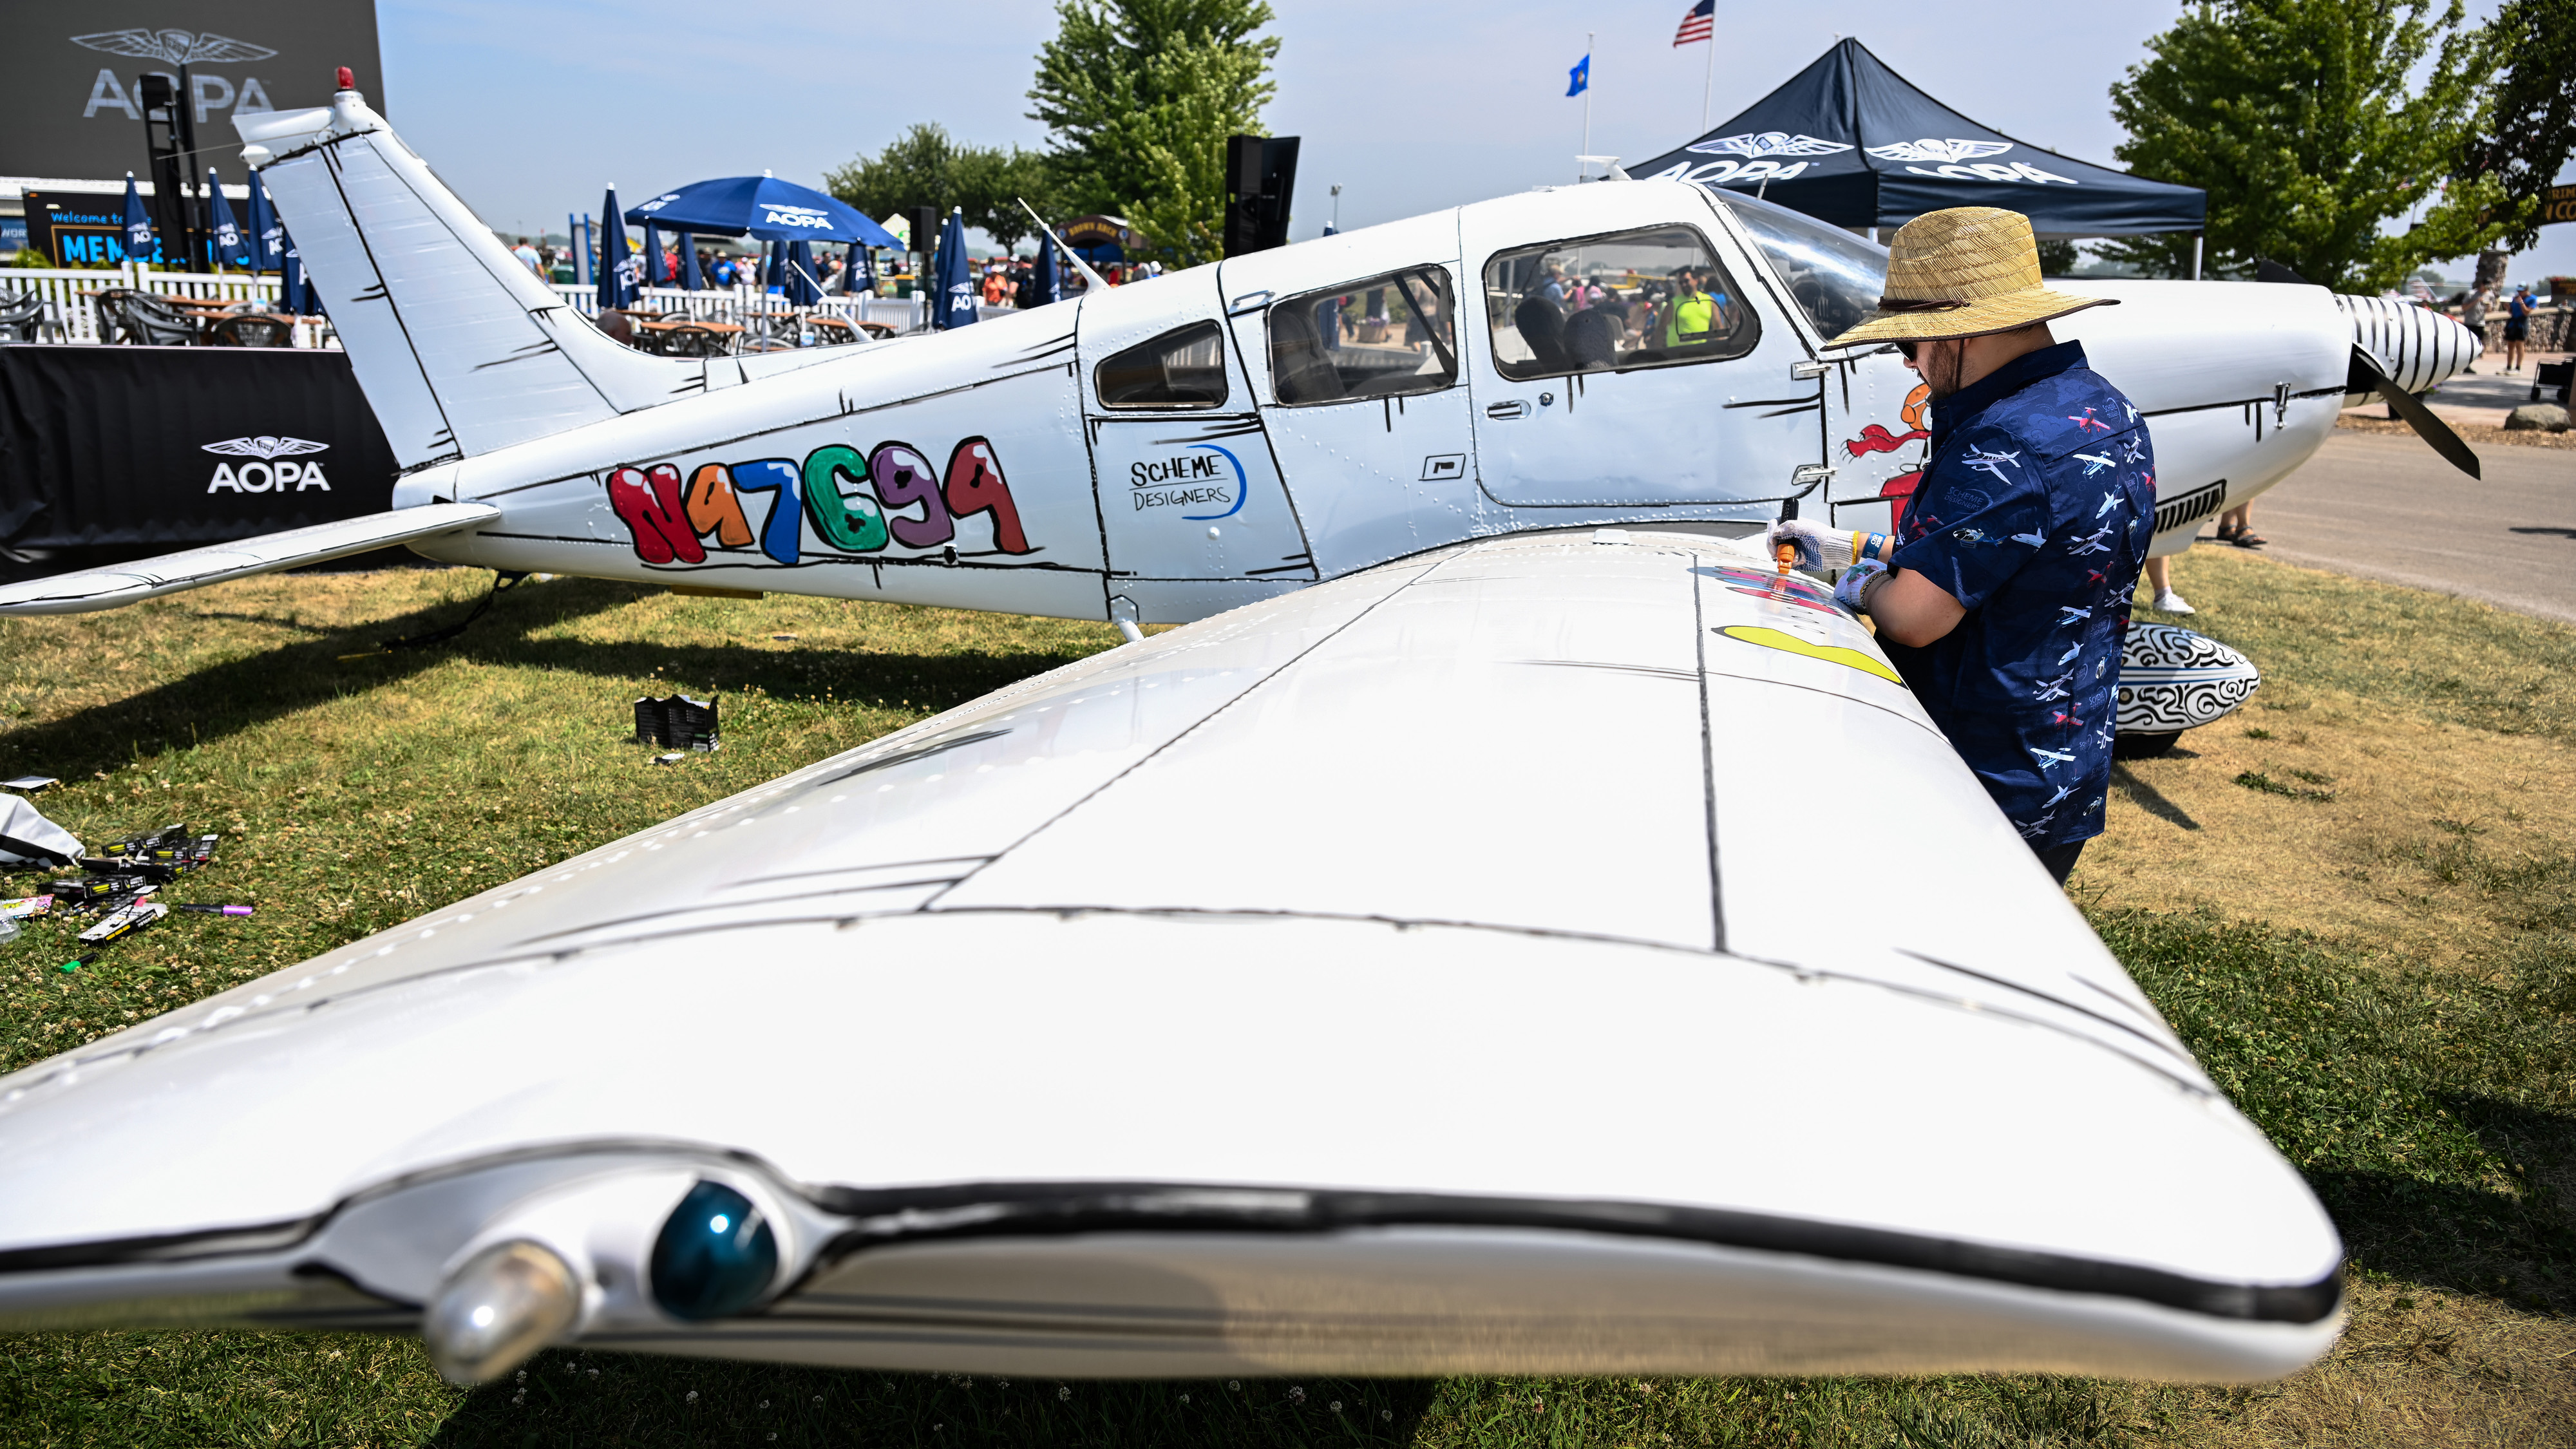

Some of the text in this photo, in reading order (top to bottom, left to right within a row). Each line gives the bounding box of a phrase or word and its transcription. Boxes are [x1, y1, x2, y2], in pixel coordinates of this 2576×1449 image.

[51, 211, 108, 223] Welcome
[765, 211, 835, 231] AOPA
[207, 461, 332, 494] AOPA
[1131, 454, 1222, 487] SCHEME
[1133, 487, 1231, 511] DESIGNERS
[1944, 495, 1981, 511] DESIGNERS
[1947, 486, 1984, 505] SCHEME
